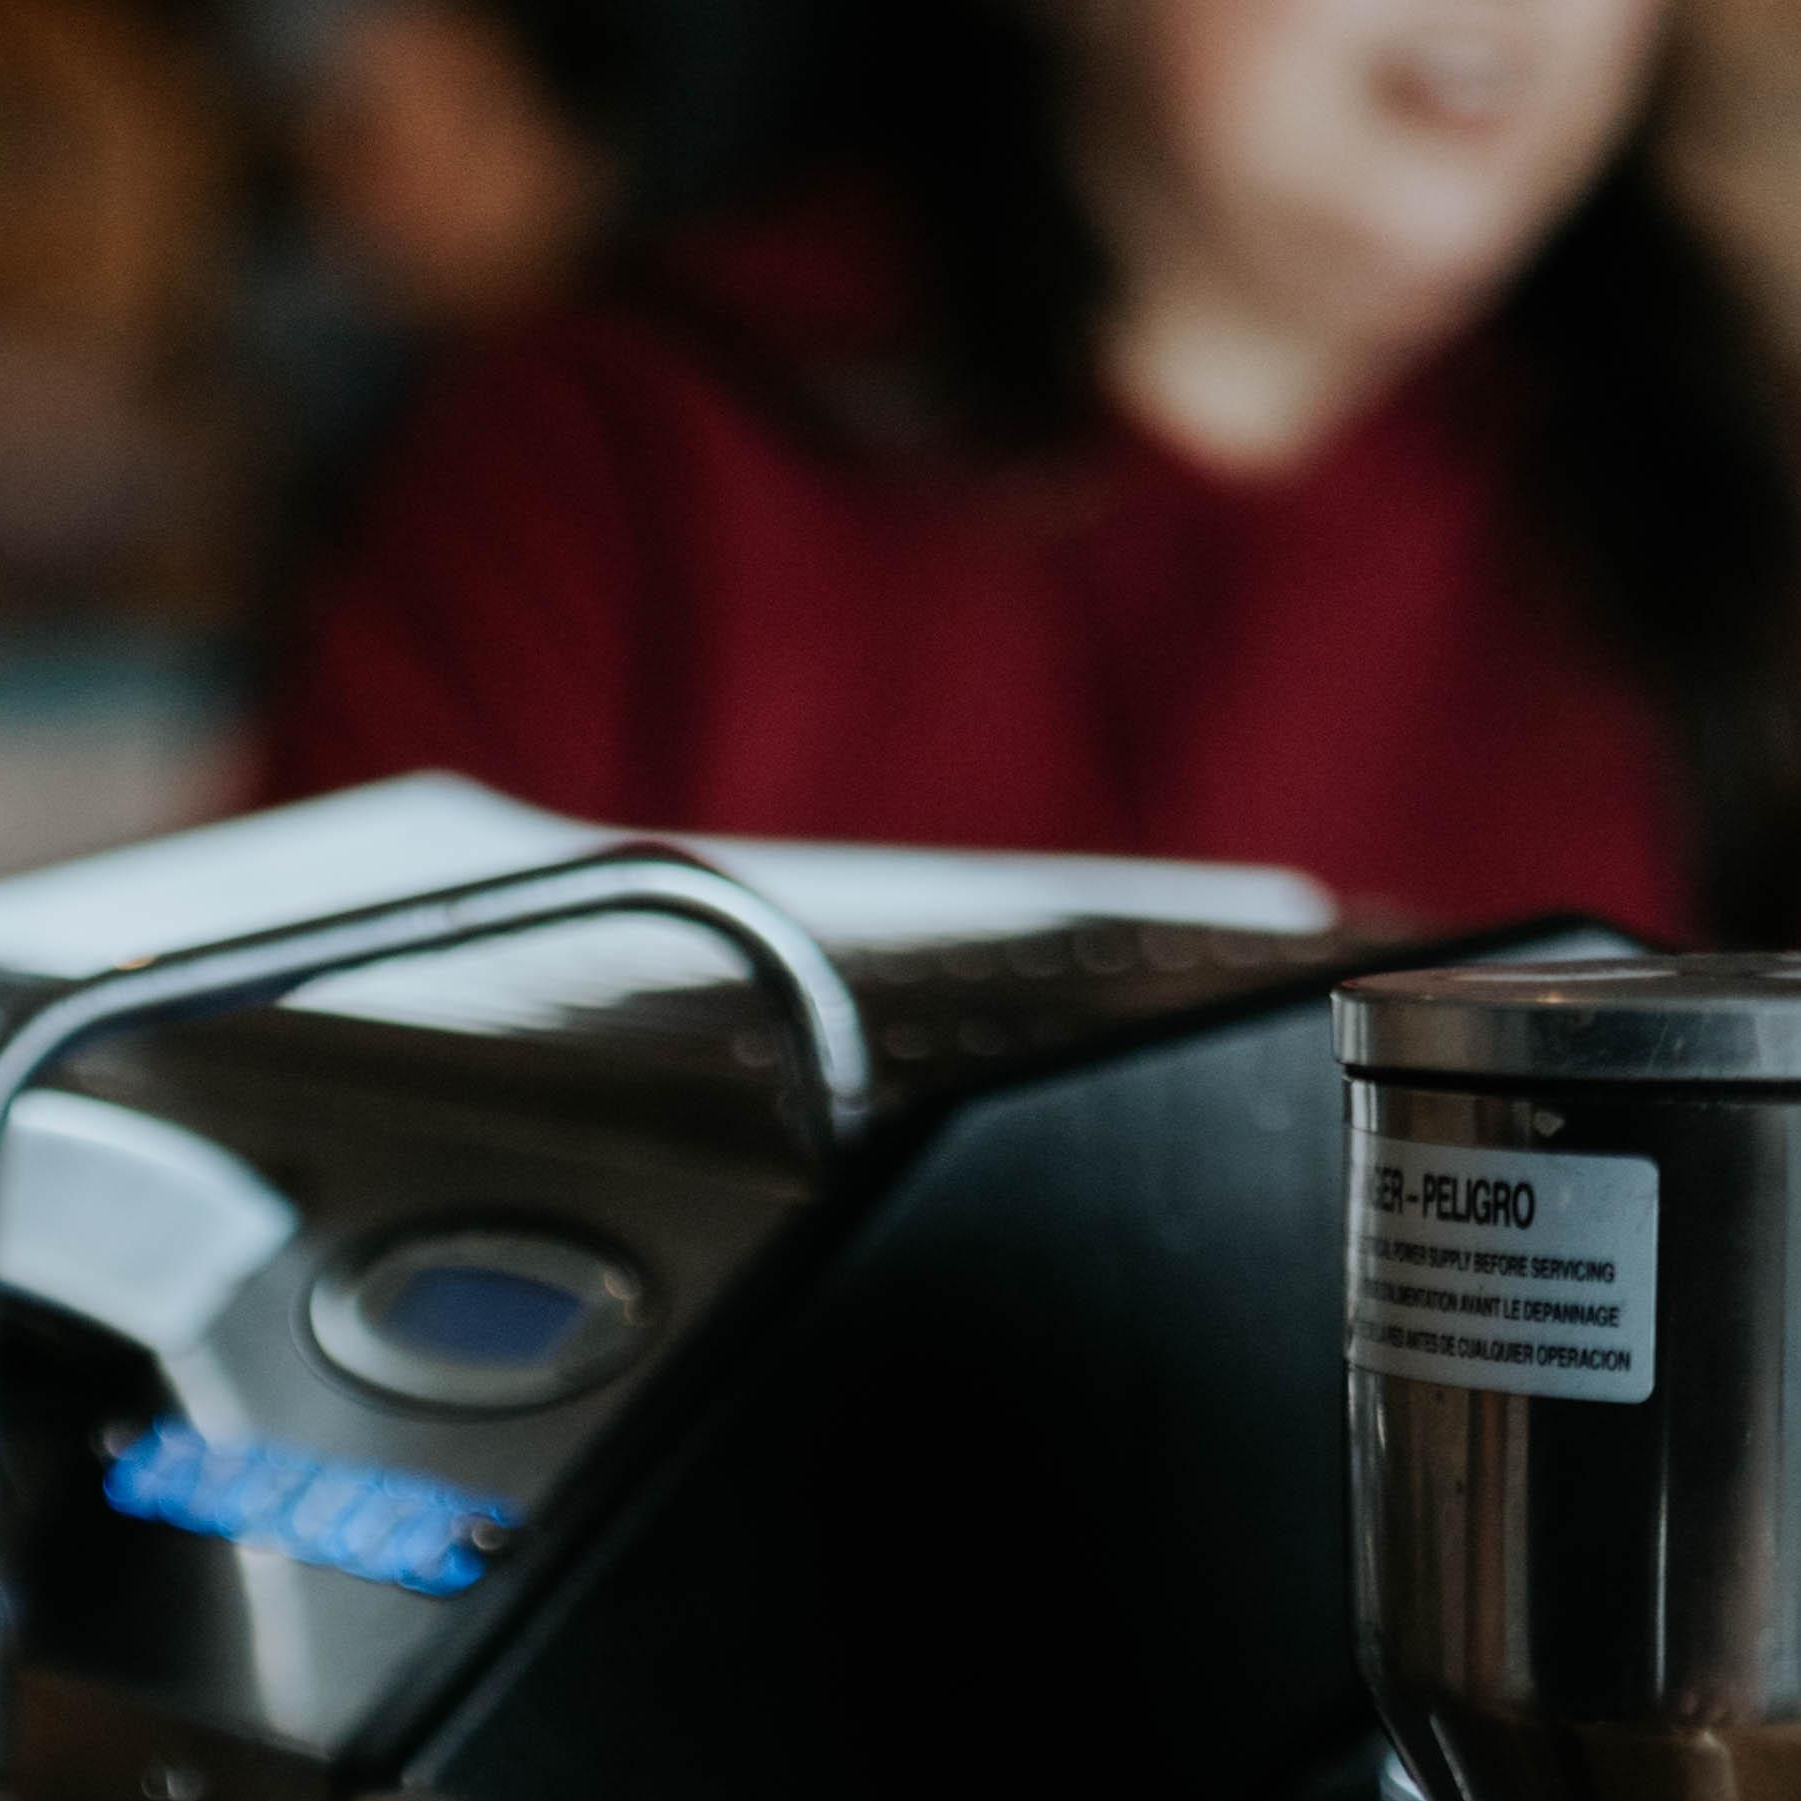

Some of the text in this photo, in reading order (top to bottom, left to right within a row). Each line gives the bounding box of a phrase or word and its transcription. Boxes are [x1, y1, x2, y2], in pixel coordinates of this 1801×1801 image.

[1422, 1172, 1536, 1230] PELIGRO
[1473, 1250, 1527, 1278] BEFORE
[1529, 1255, 1616, 1284] SERVICING
[1502, 1298, 1521, 1321] LE
[1523, 1299, 1621, 1329] DEPANNAGE
[1456, 1337, 1534, 1366] CUALQUIER
[1536, 1342, 1631, 1373] OPERACION
